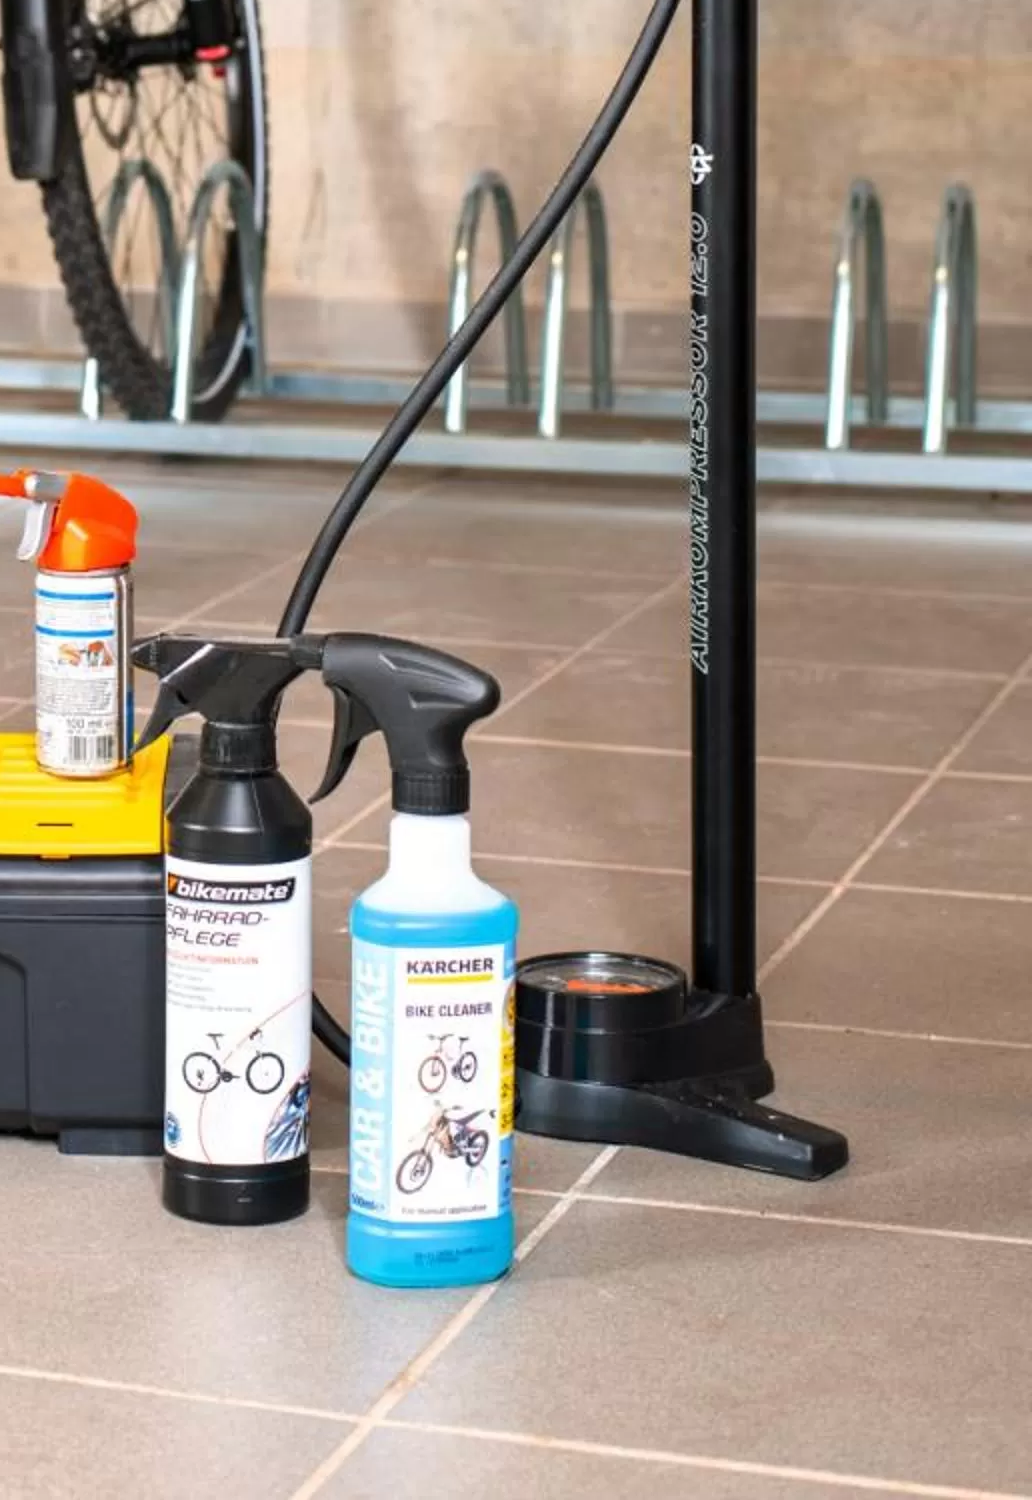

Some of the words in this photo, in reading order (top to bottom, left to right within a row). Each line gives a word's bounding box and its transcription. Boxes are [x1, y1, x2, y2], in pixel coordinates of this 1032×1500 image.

[177, 879, 289, 901] bikemate
[406, 957, 494, 975] KÄRCHER
[355, 957, 388, 1056] BIKE
[405, 1004, 436, 1017] BIKE
[438, 1002, 492, 1017] CLEANER
[355, 1066, 385, 1100] &
[352, 1106, 385, 1190] CAR
